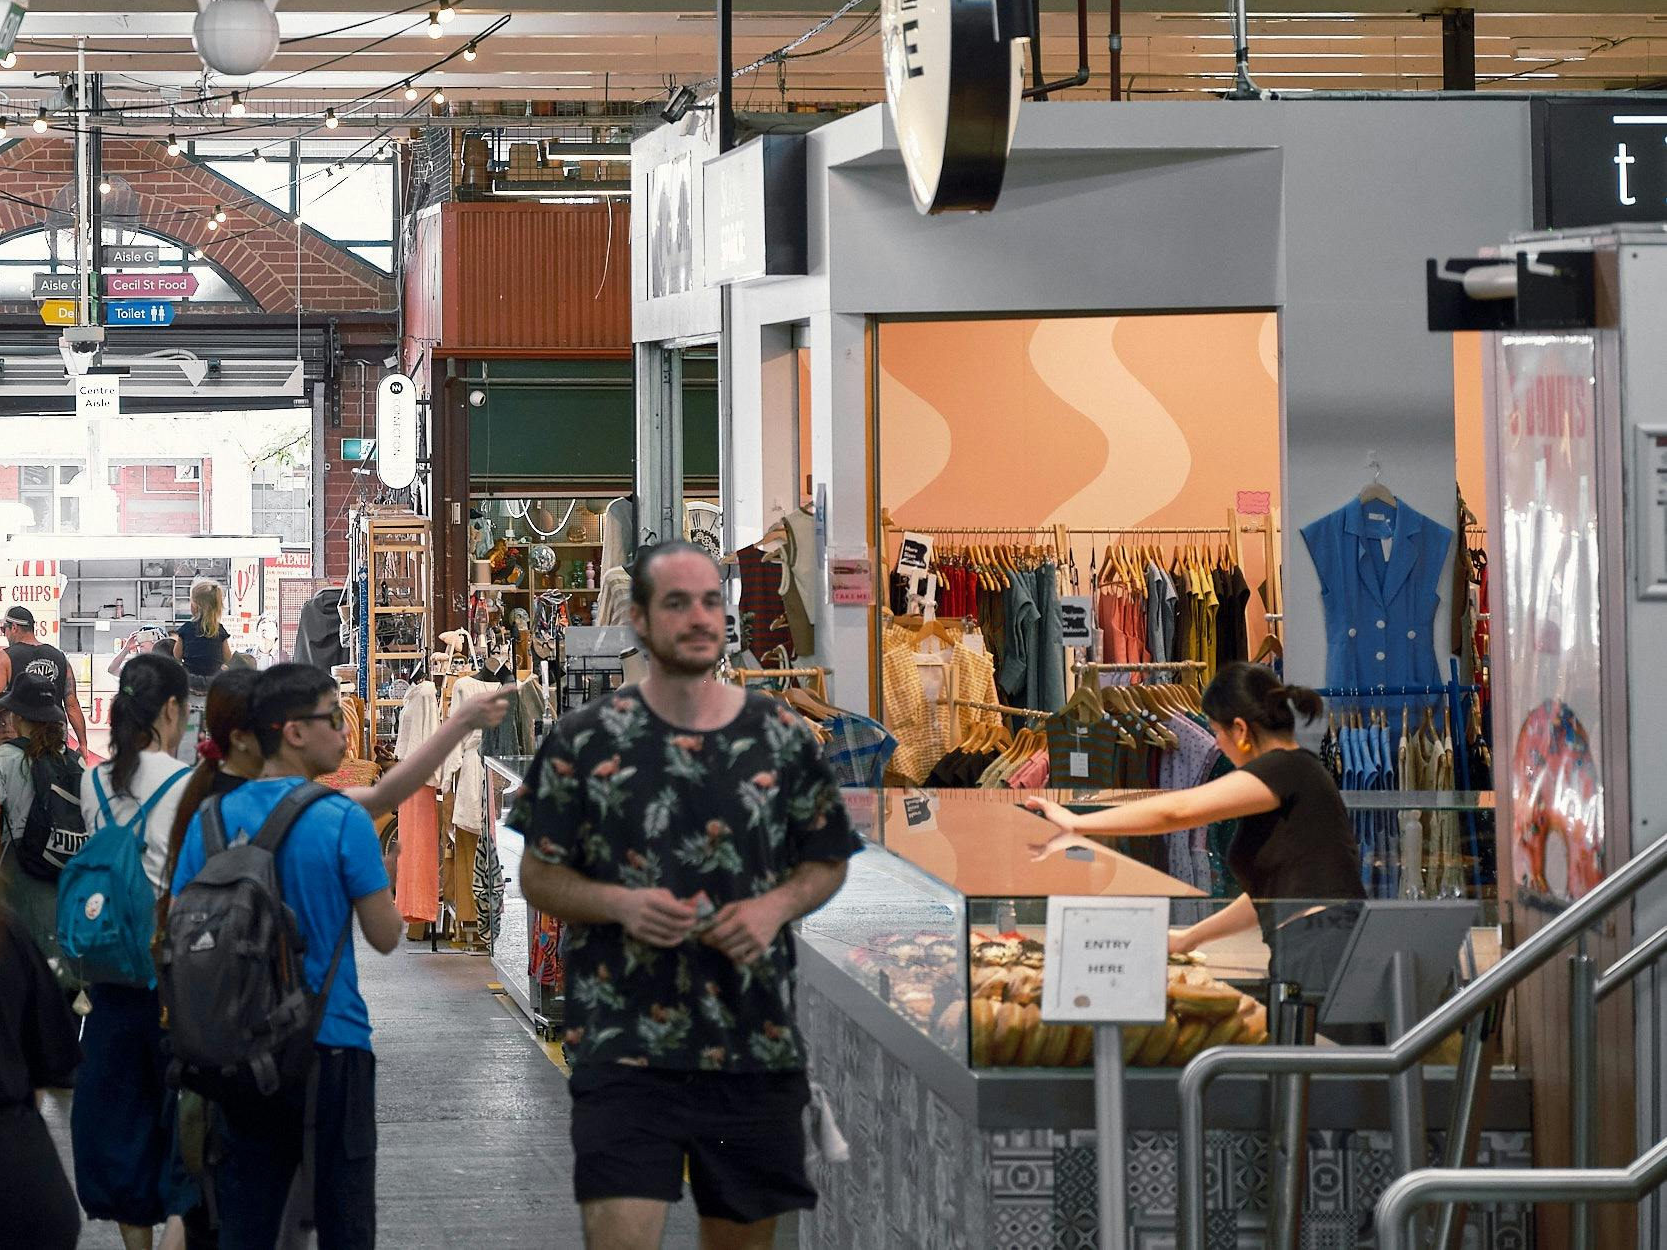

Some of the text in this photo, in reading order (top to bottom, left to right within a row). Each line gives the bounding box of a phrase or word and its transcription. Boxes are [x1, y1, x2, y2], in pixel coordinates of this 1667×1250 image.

[113, 251, 154, 262] Aisle G
[40, 280, 68, 291] Aisle
[112, 279, 187, 291] Cecil St Food
[114, 307, 146, 319] Toilet
[79, 386, 115, 395] Centre
[85, 398, 110, 407] Aisle
[275, 553, 310, 566] MENU
[12, 585, 51, 602] CHIPS
[1084, 939, 1132, 950] ENTRY
[1087, 963, 1126, 974] HERE
